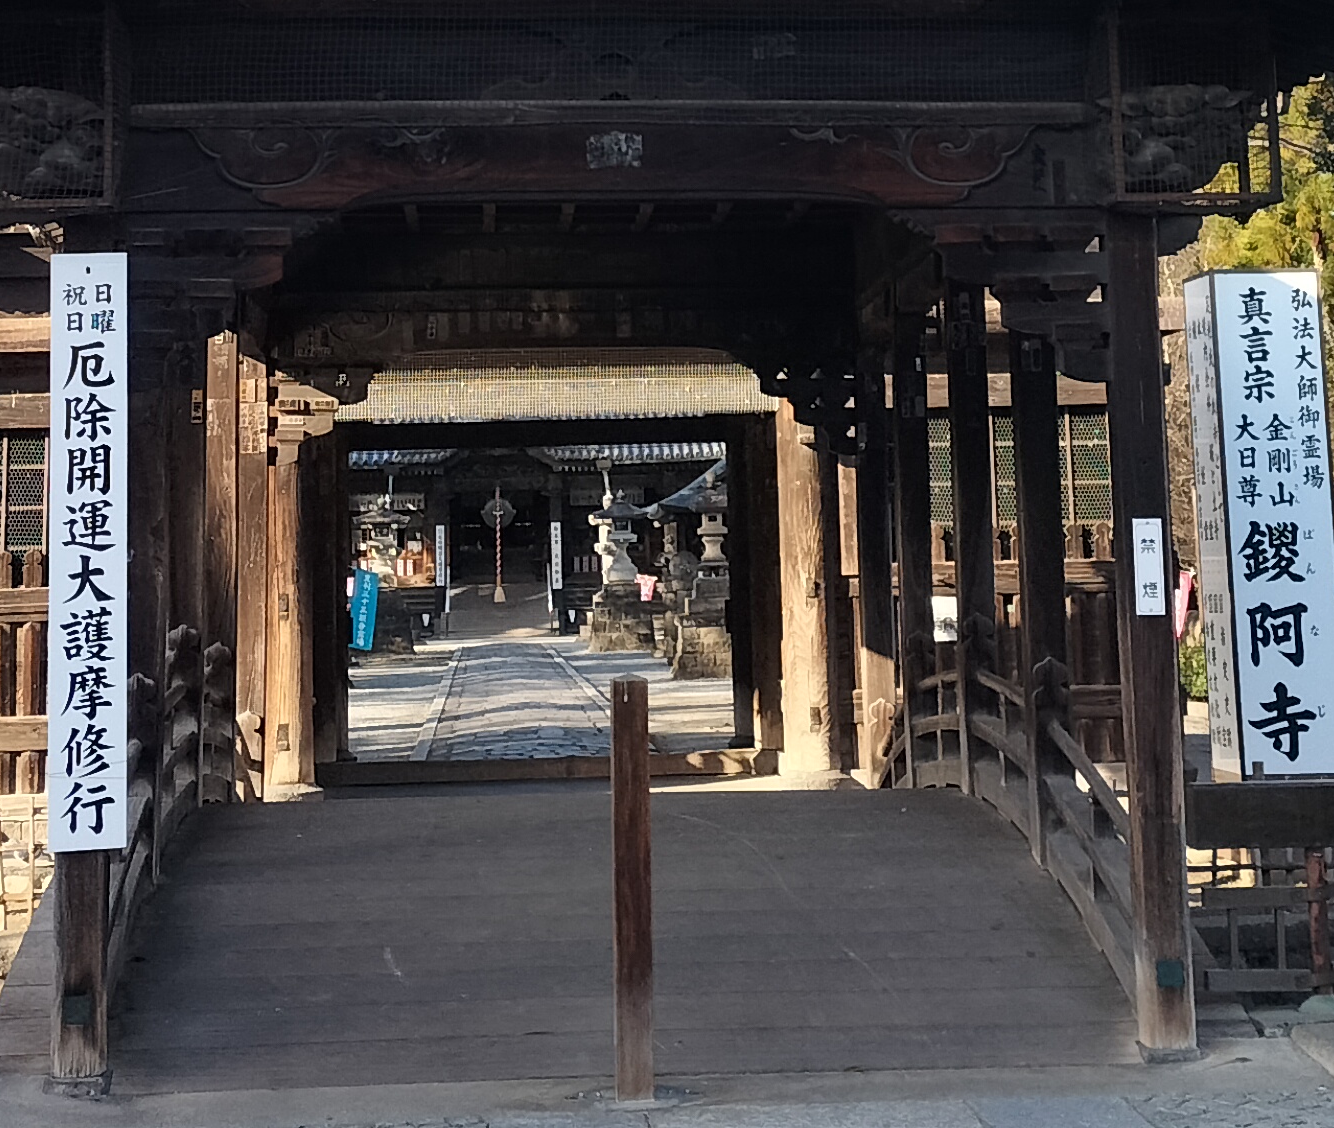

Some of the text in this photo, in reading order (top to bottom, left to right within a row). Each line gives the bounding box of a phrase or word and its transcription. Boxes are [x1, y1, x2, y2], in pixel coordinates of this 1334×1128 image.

[62, 283, 88, 333] 祝日
[90, 283, 117, 334] 日曜
[1237, 286, 1275, 404] 真言宗
[1290, 288, 1325, 489] 弘法大師御霊場
[1233, 413, 1262, 508] 大日尊
[1262, 413, 1295, 508] 金剛山
[60, 341, 117, 835] 厄除開運大護摩修行
[1140, 537, 1158, 599] 禁煙
[1237, 520, 1317, 762] 鑁阿寺
